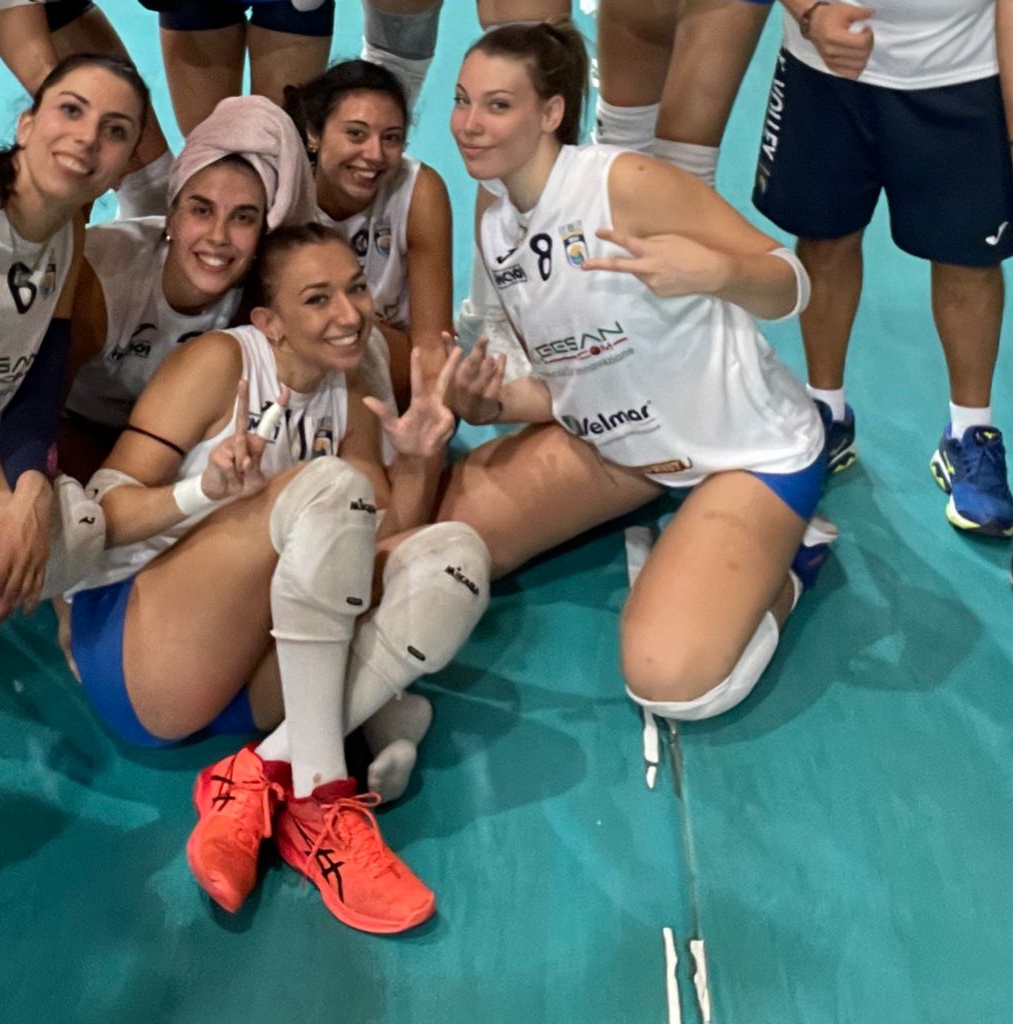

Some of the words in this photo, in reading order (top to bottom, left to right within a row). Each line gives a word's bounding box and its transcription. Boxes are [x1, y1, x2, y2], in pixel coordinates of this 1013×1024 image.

[529, 232, 553, 281] 8
[7, 261, 37, 314] 6
[535, 321, 624, 358] GESAN
[577, 404, 649, 436] Velmar
